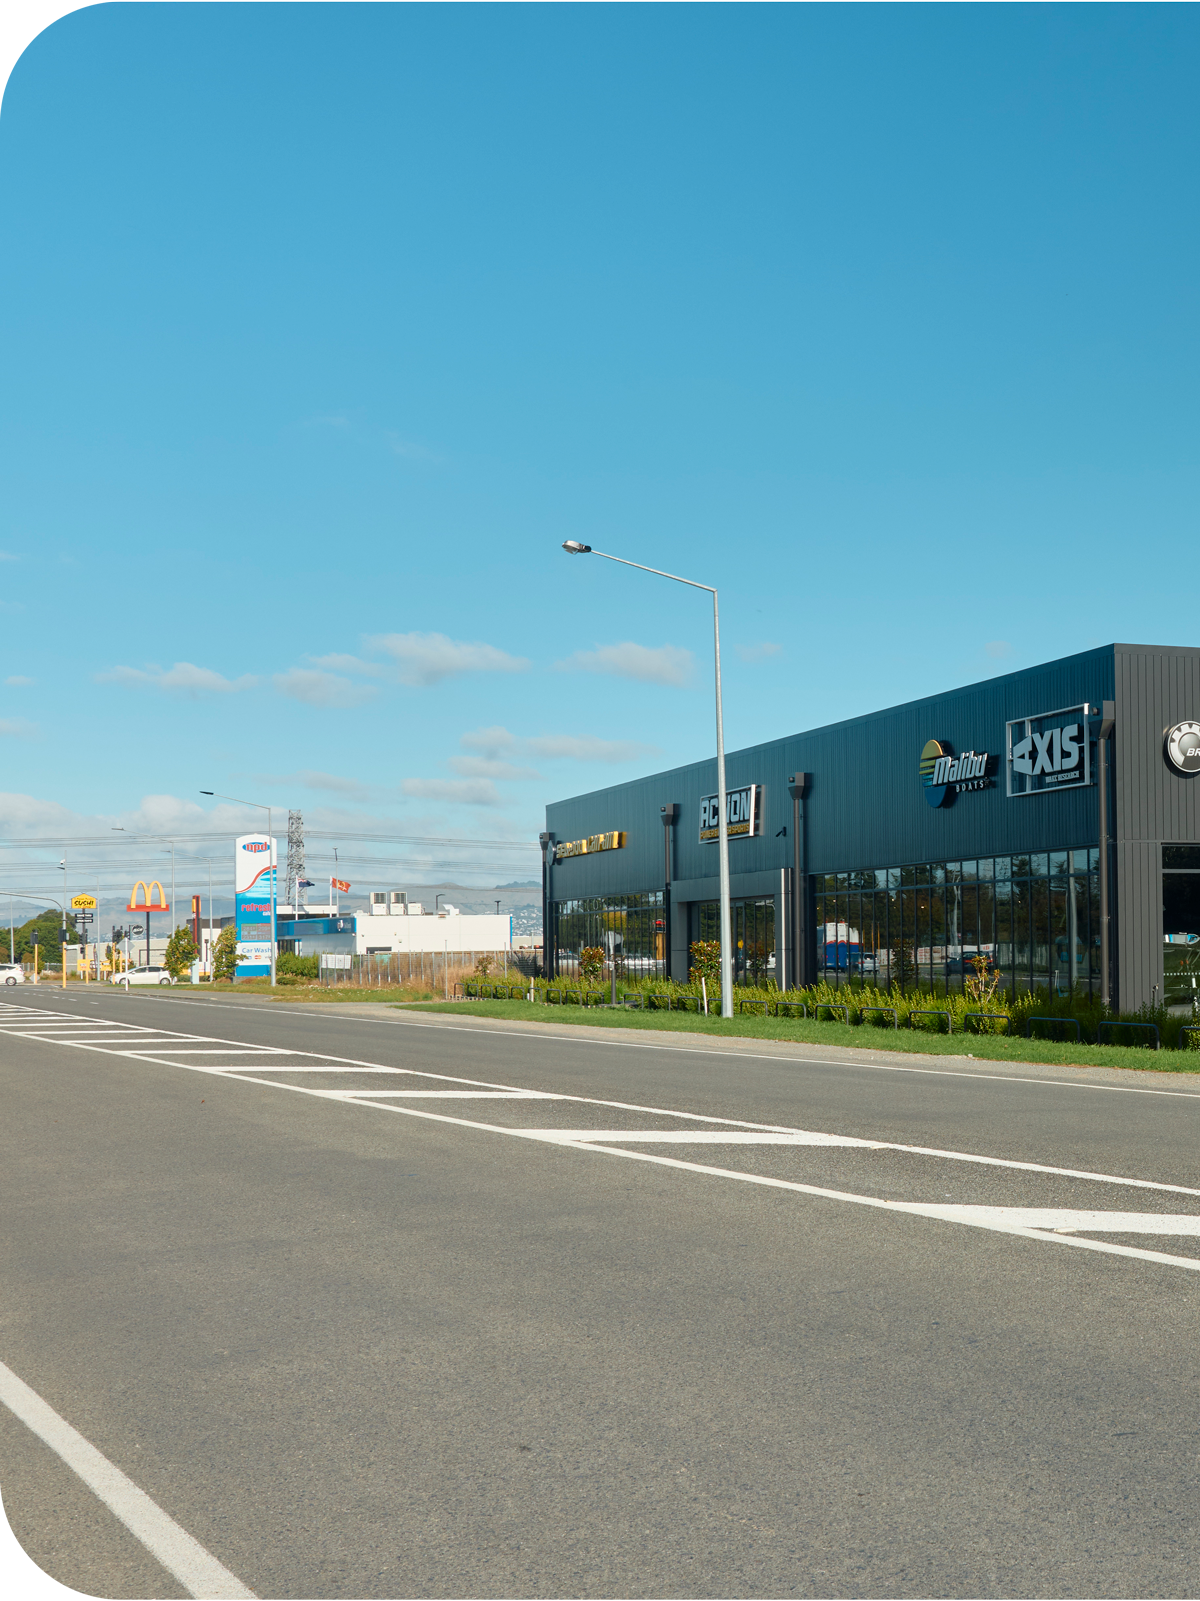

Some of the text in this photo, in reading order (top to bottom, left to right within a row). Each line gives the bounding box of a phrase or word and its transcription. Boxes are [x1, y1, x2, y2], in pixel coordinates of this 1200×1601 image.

[1013, 723, 1080, 775] AXIS
[932, 750, 988, 785] Malibu
[956, 780, 984, 792] BOATS
[700, 791, 751, 828] ACION
[246, 842, 268, 853] npd
